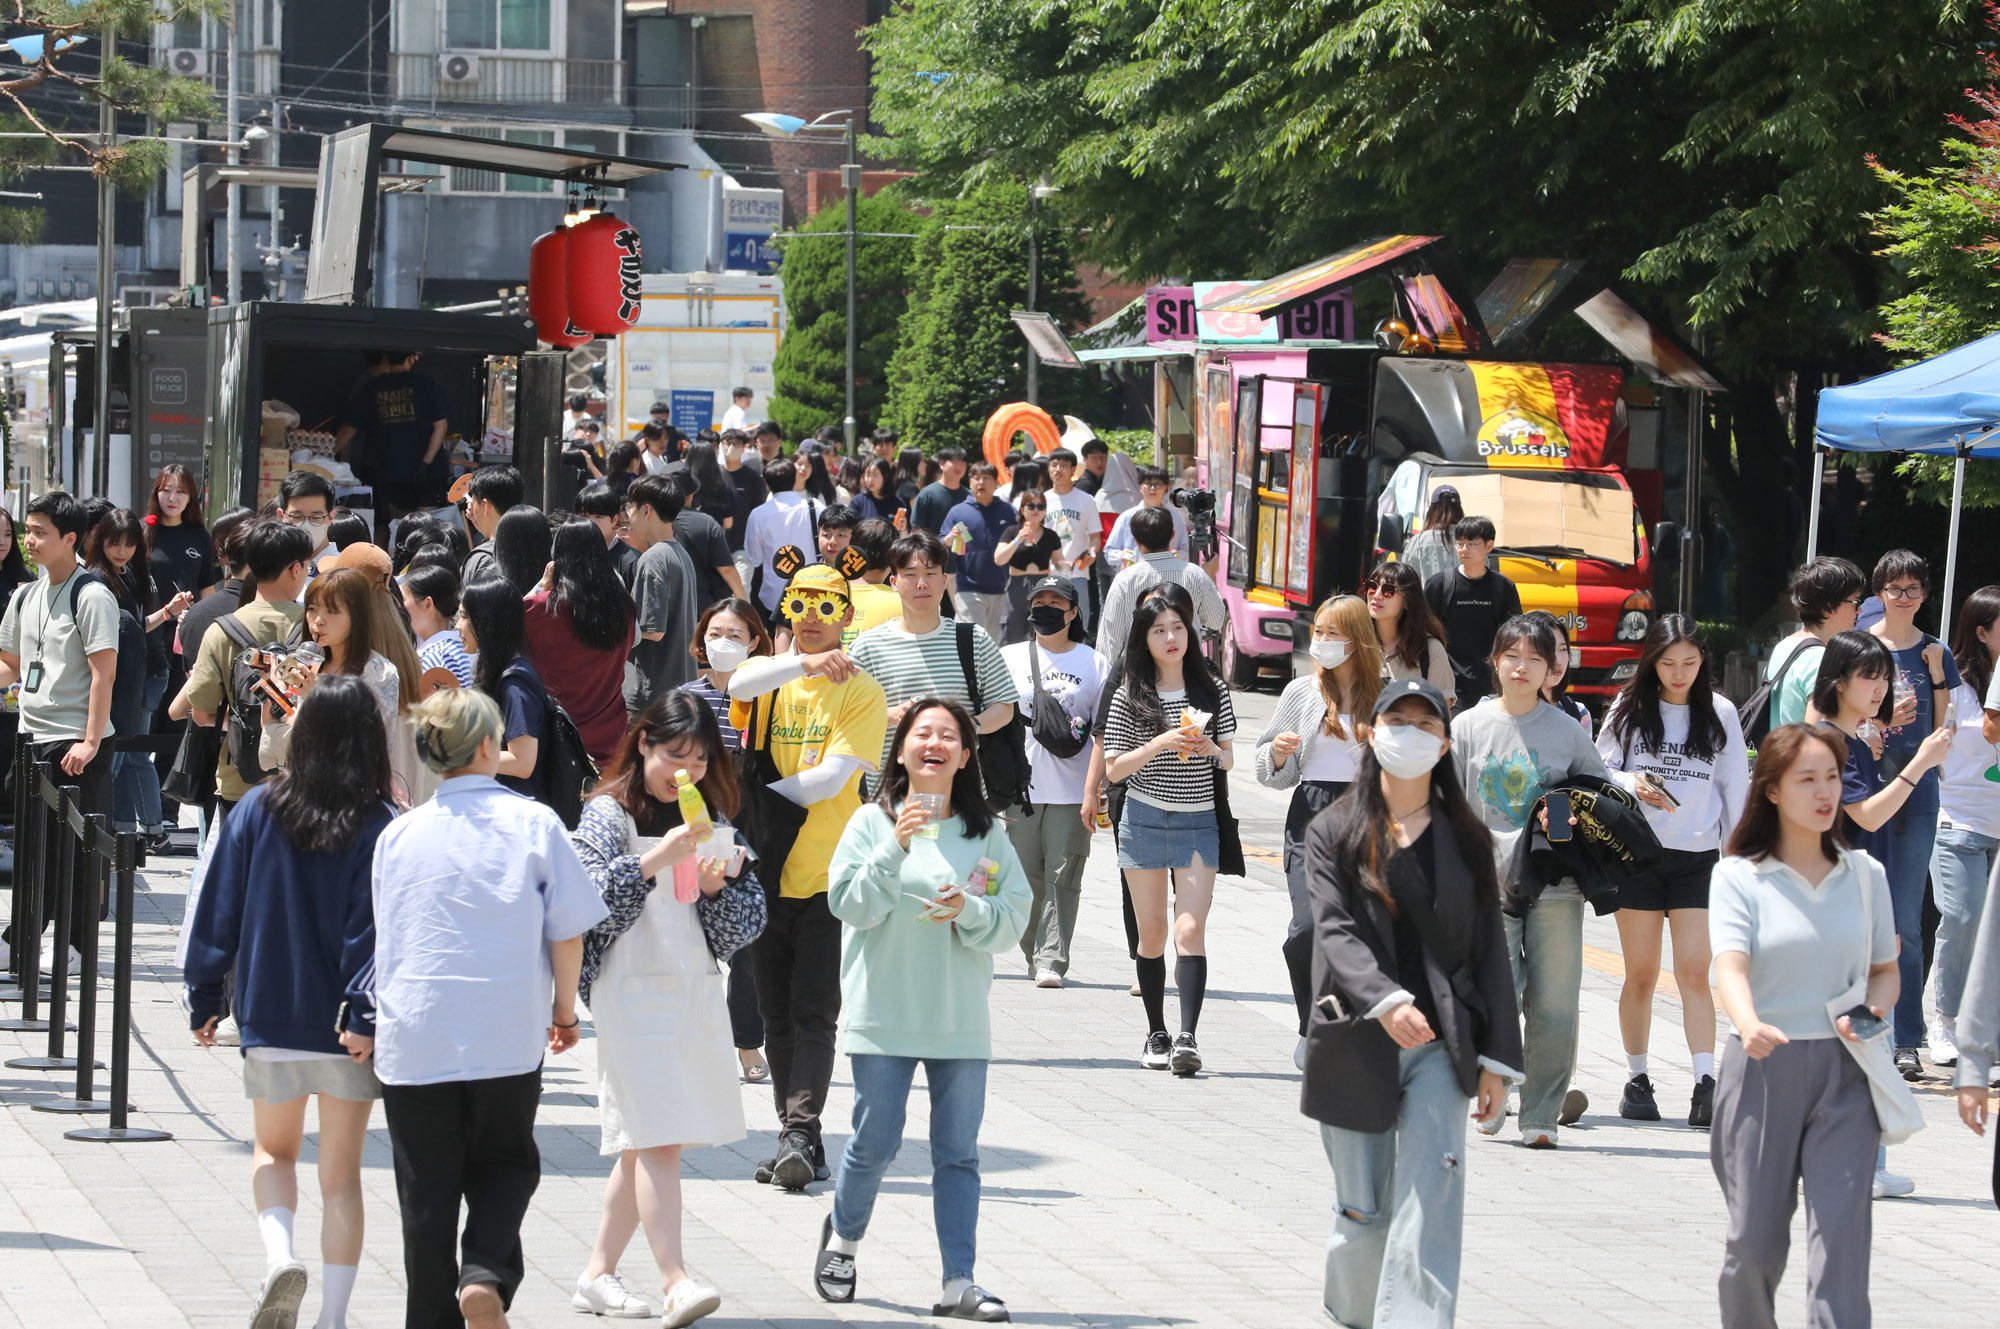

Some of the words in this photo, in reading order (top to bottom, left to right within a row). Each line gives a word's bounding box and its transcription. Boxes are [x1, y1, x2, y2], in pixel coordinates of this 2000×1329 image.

[155, 375, 182, 383] FOOD
[154, 384, 183, 392] TRUCK
[150, 414, 187, 423] PRIME
[1477, 440, 1569, 459] Brussels
[1026, 671, 1082, 685] PANUTS
[1679, 769, 1711, 781] COLLEGE
